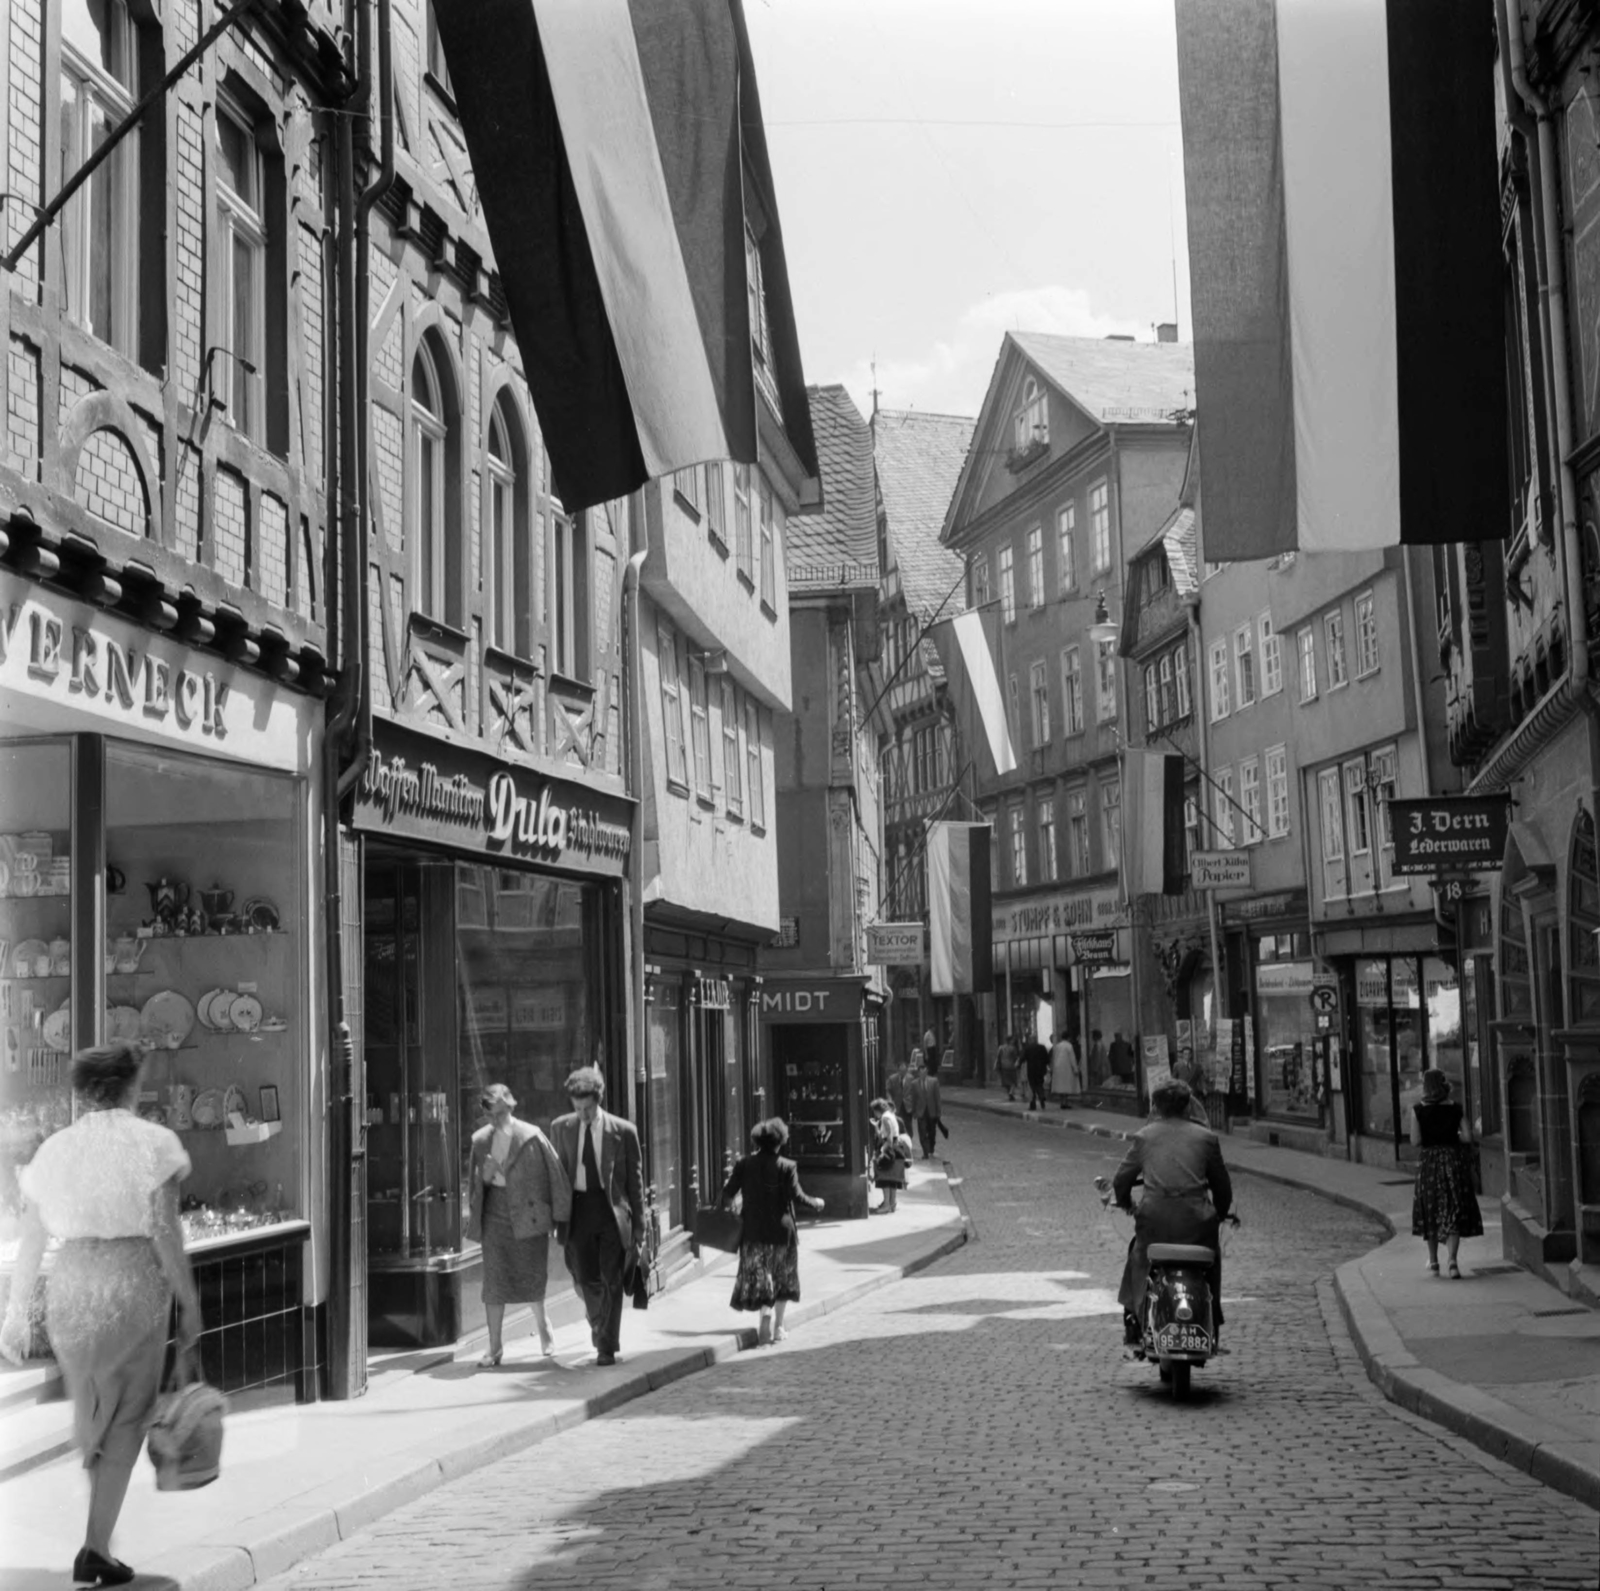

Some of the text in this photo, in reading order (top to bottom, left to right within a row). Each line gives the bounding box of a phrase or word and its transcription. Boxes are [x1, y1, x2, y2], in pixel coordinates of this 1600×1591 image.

[1409, 811, 1490, 834] J. Dern
[1409, 837, 1491, 855] Lederwaren
[1198, 867, 1246, 883] Papier
[1444, 882, 1462, 900] 18
[1064, 898, 1093, 926] SOHN
[873, 934, 918, 946] TEXTOR
[763, 991, 829, 1012] MIDT
[1320, 991, 1332, 1009] P
